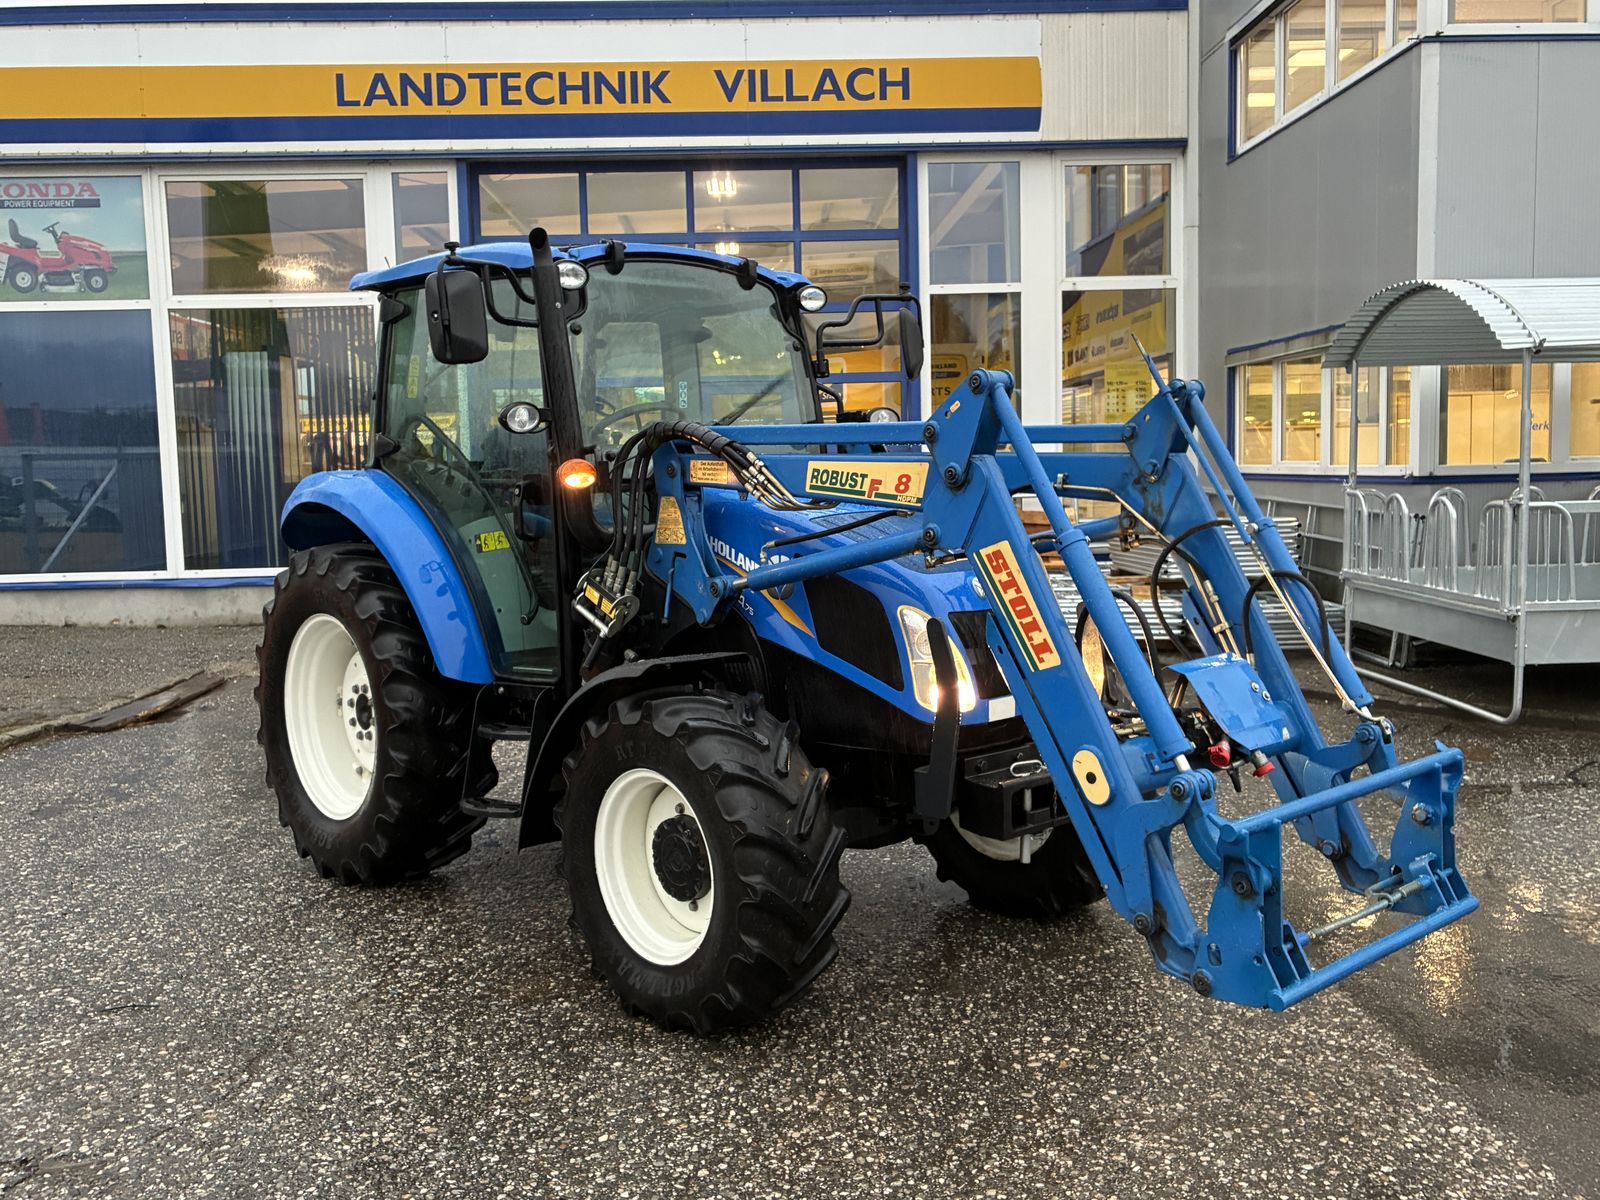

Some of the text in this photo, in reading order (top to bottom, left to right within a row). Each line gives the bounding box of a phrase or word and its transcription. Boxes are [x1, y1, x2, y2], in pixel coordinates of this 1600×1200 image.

[334, 66, 911, 108] LANDTECHNIK VILLACH
[0, 182, 100, 198] ONDA
[4, 199, 75, 208] POWER EQUIPMENT
[810, 468, 912, 498] ROBUST F 8
[985, 549, 1054, 664] STOLL
